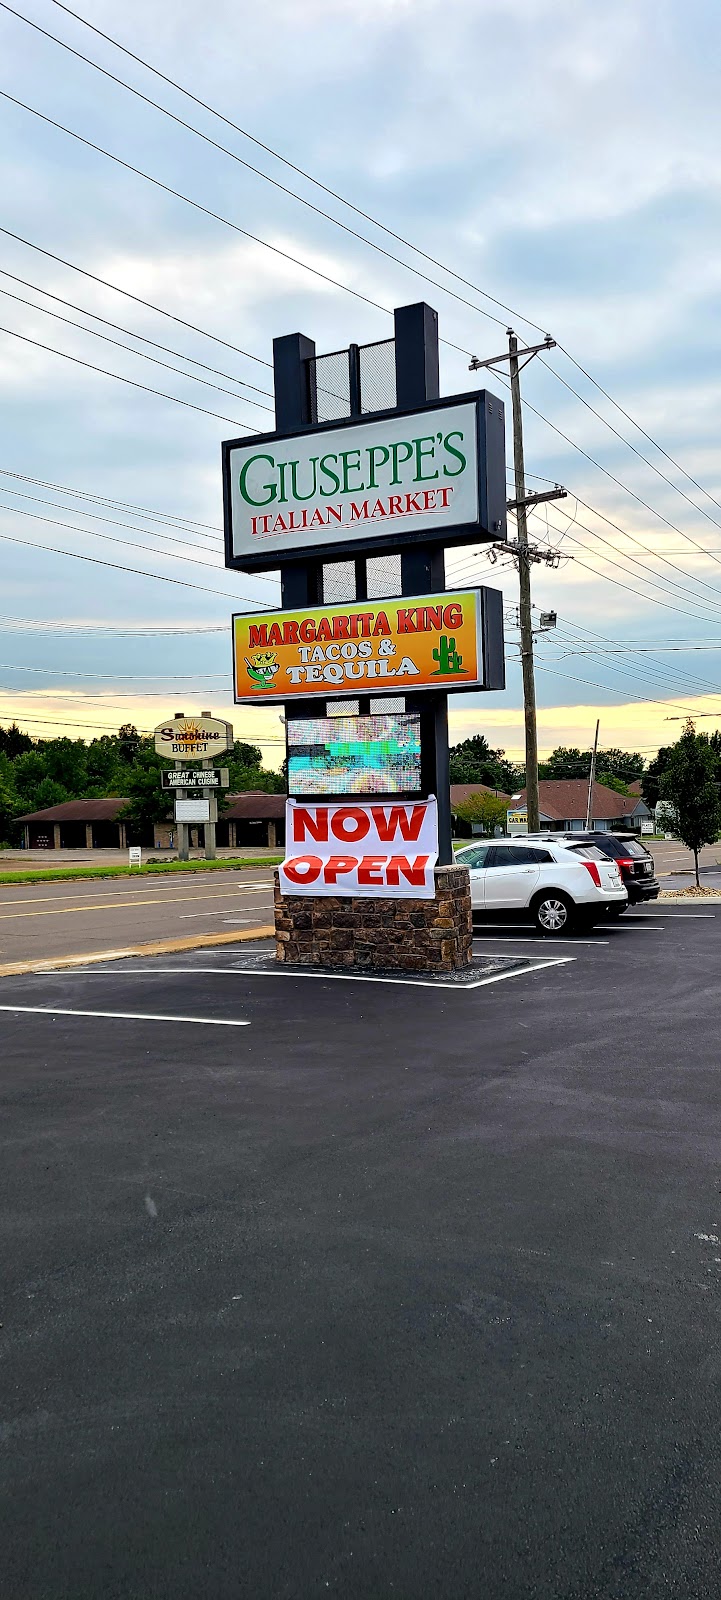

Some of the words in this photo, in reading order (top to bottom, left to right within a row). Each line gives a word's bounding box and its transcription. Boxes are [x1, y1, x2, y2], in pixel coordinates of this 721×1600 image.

[239, 431, 467, 506] GIUSEPPE'S
[250, 504, 343, 535] ITALIAN
[350, 487, 454, 521] MARKET
[248, 611, 392, 648] MARGARITA
[397, 603, 464, 634] KING
[298, 641, 373, 663] TACOS
[378, 638, 397, 656] &
[285, 657, 420, 684] TEQUILA
[161, 728, 220, 741] Sunshine
[172, 743, 208, 752] BUFFET
[293, 806, 427, 842] NOW
[283, 854, 430, 886] OPEN
